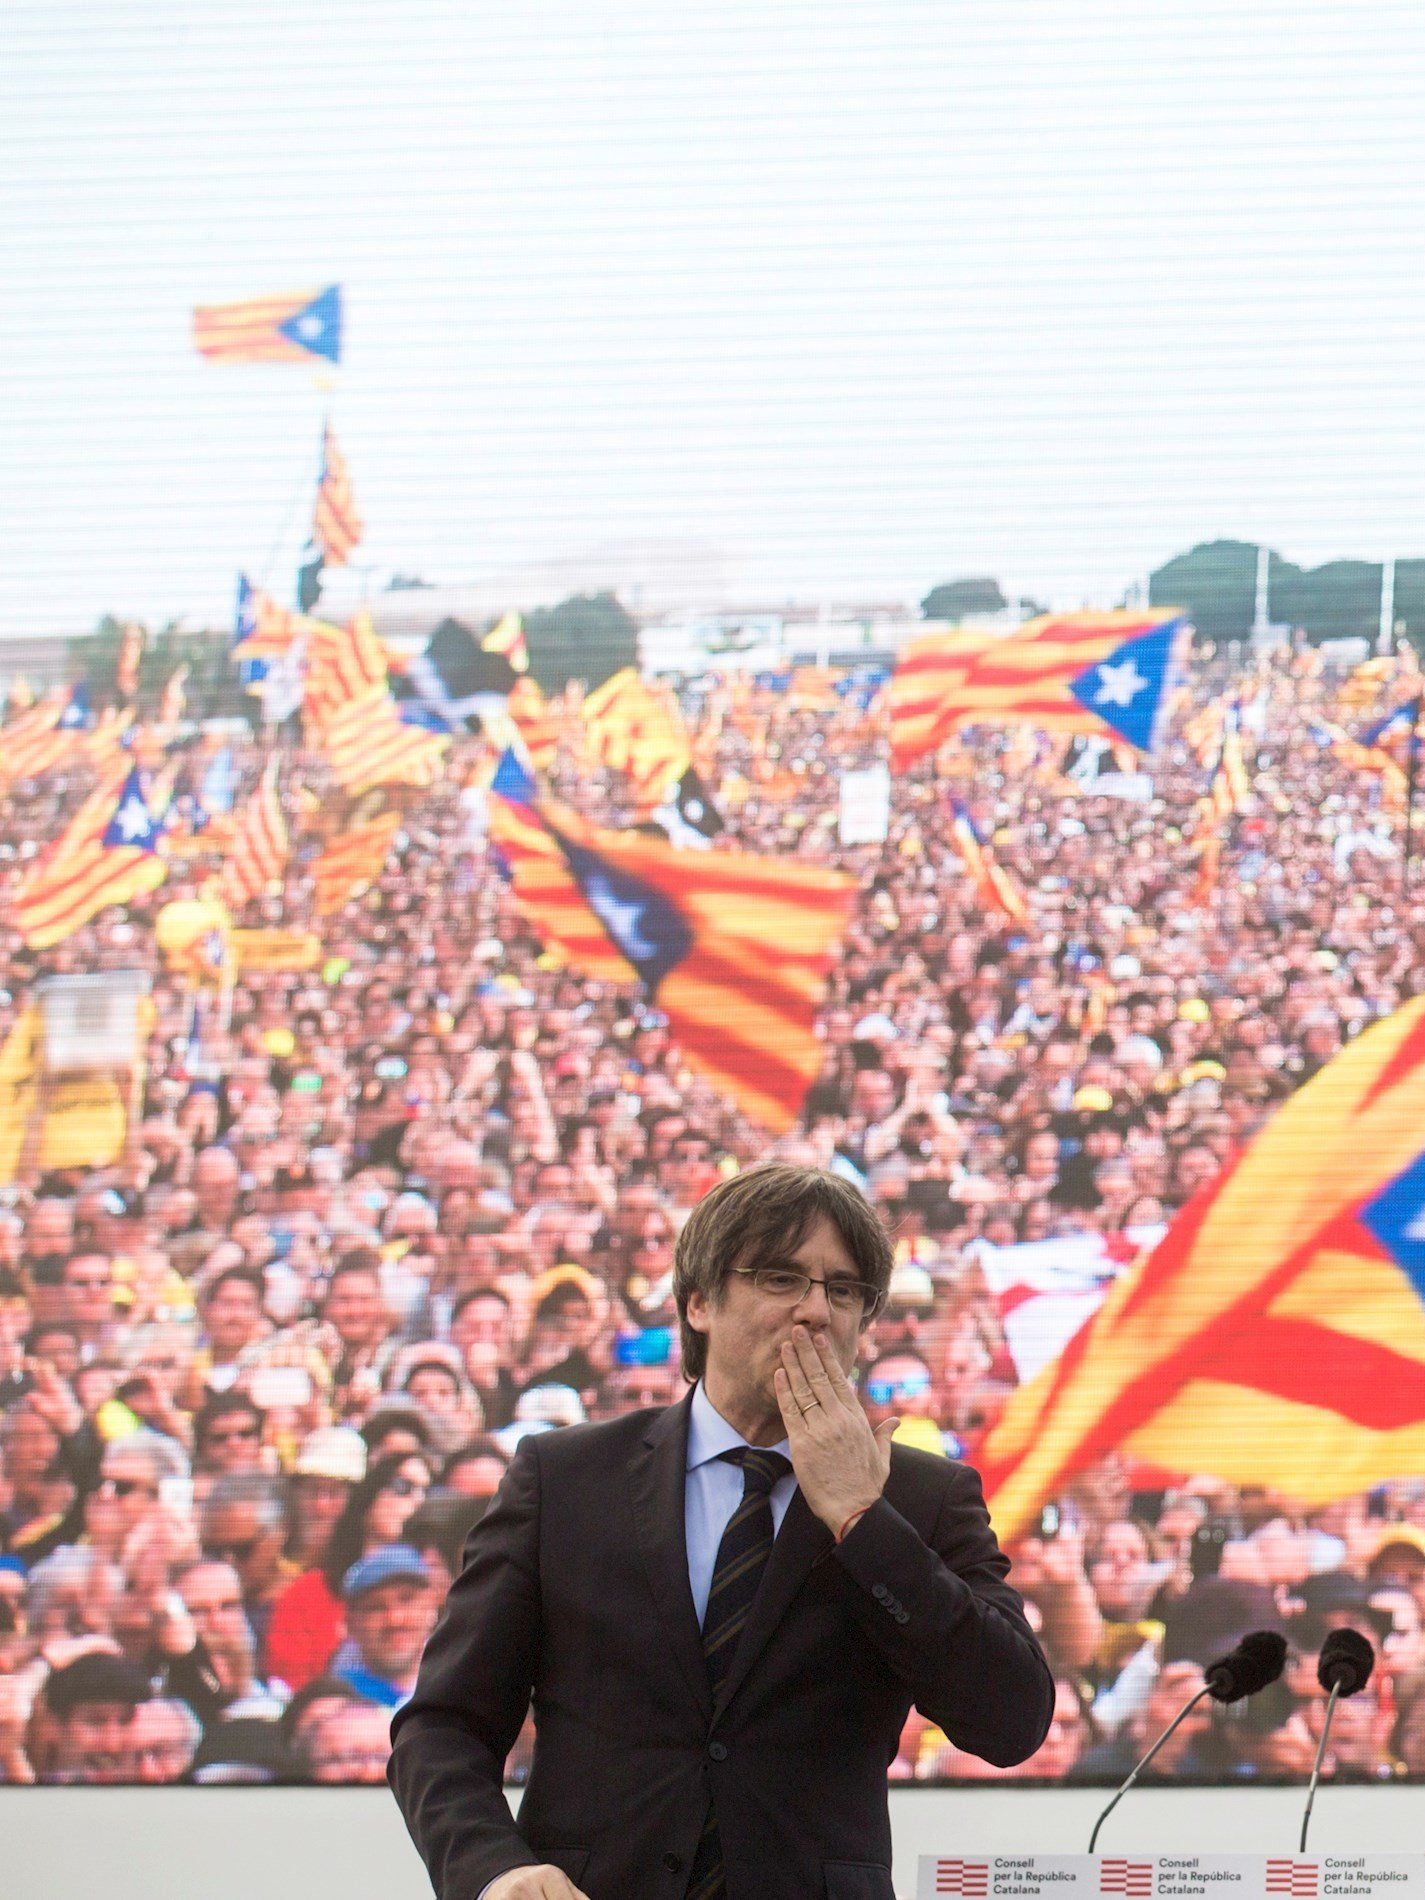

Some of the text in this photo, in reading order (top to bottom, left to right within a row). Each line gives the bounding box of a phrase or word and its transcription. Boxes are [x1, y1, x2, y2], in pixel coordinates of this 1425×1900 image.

[994, 1857, 1033, 1868] Consell
[1159, 1857, 1199, 1868] Consell
[1325, 1857, 1364, 1868] Consell
[993, 1870, 1076, 1883] per la República
[1158, 1870, 1241, 1883] per la República
[1324, 1870, 1408, 1883] per la República
[993, 1884, 1040, 1894] Catalana
[1158, 1884, 1205, 1894] Catalana
[1324, 1884, 1371, 1894] Catalana
